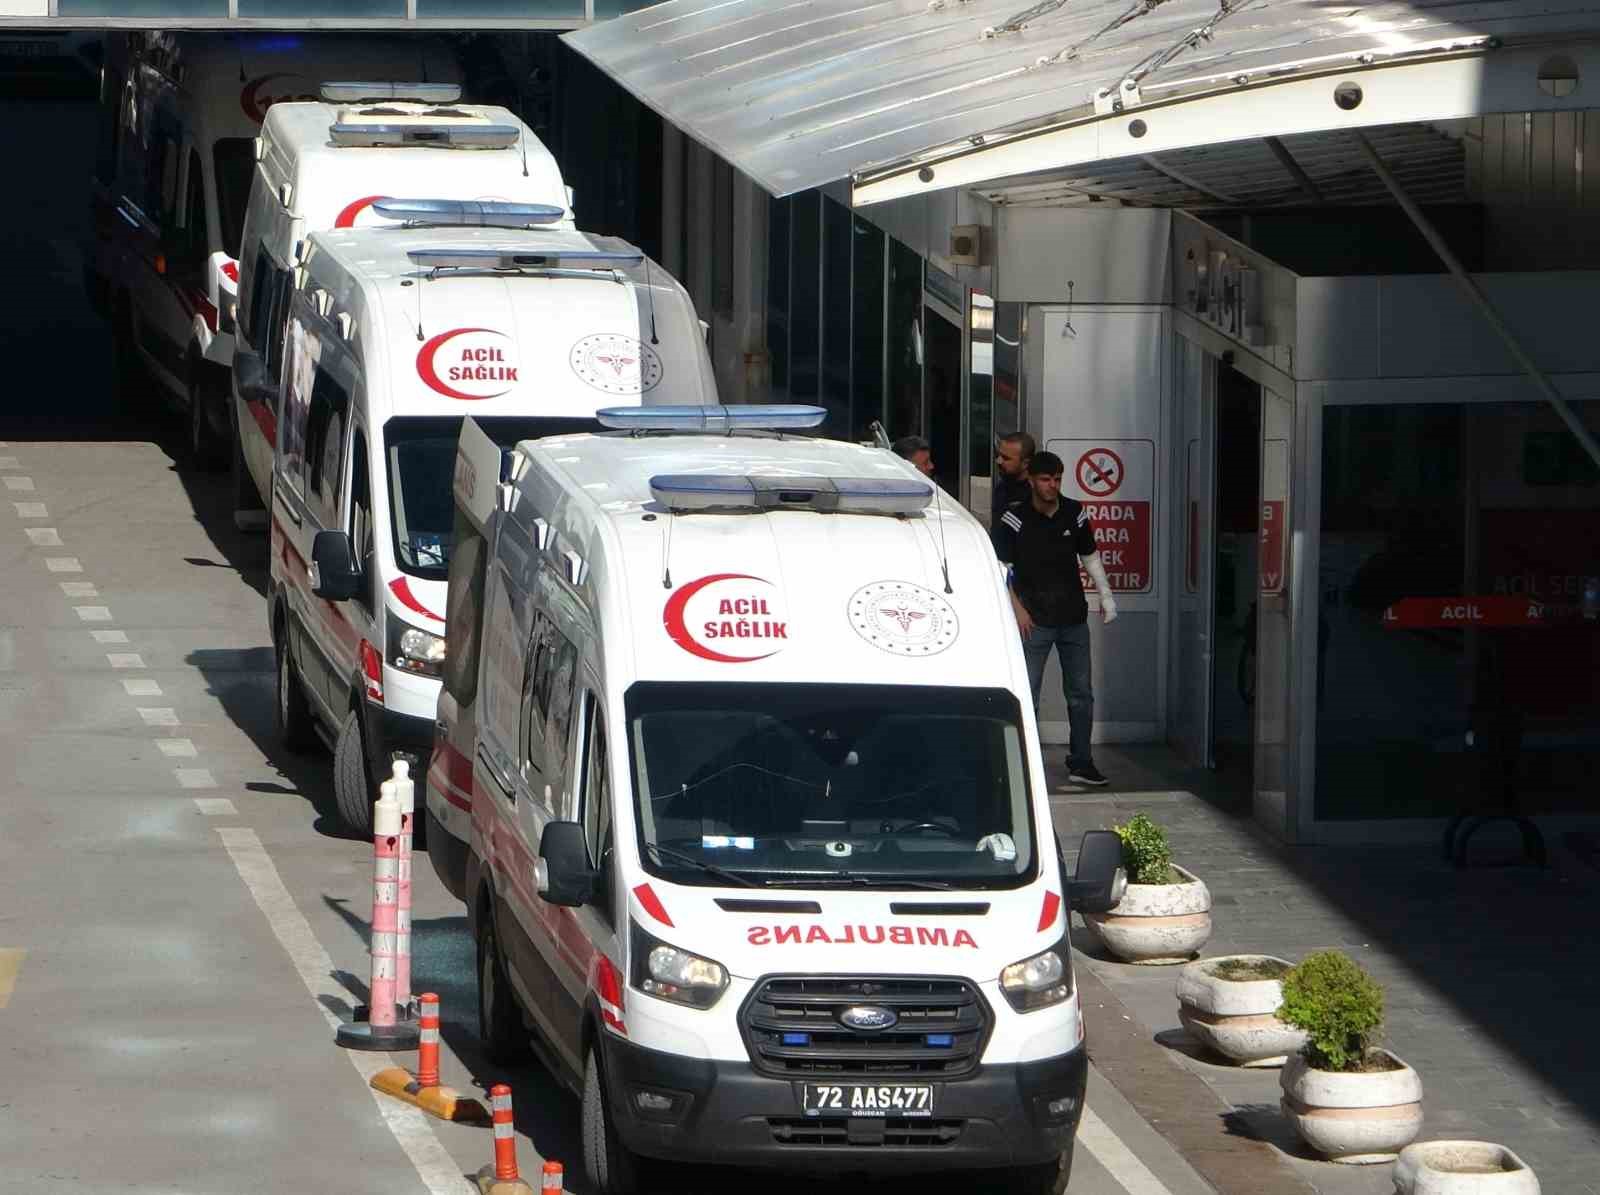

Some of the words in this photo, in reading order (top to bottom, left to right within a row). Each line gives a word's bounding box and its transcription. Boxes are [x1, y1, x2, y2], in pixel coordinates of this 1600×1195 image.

[461, 347, 505, 361] ACİL
[448, 364, 518, 381] SAĞLIK
[1083, 505, 1136, 521] RADA
[1094, 527, 1130, 543] ARA
[719, 595, 771, 615] ACİL
[1440, 604, 1484, 619] ACİL
[704, 617, 788, 639] SAĞLIK
[817, 1087, 843, 1108] 72
[851, 1087, 930, 1108] AAS477
